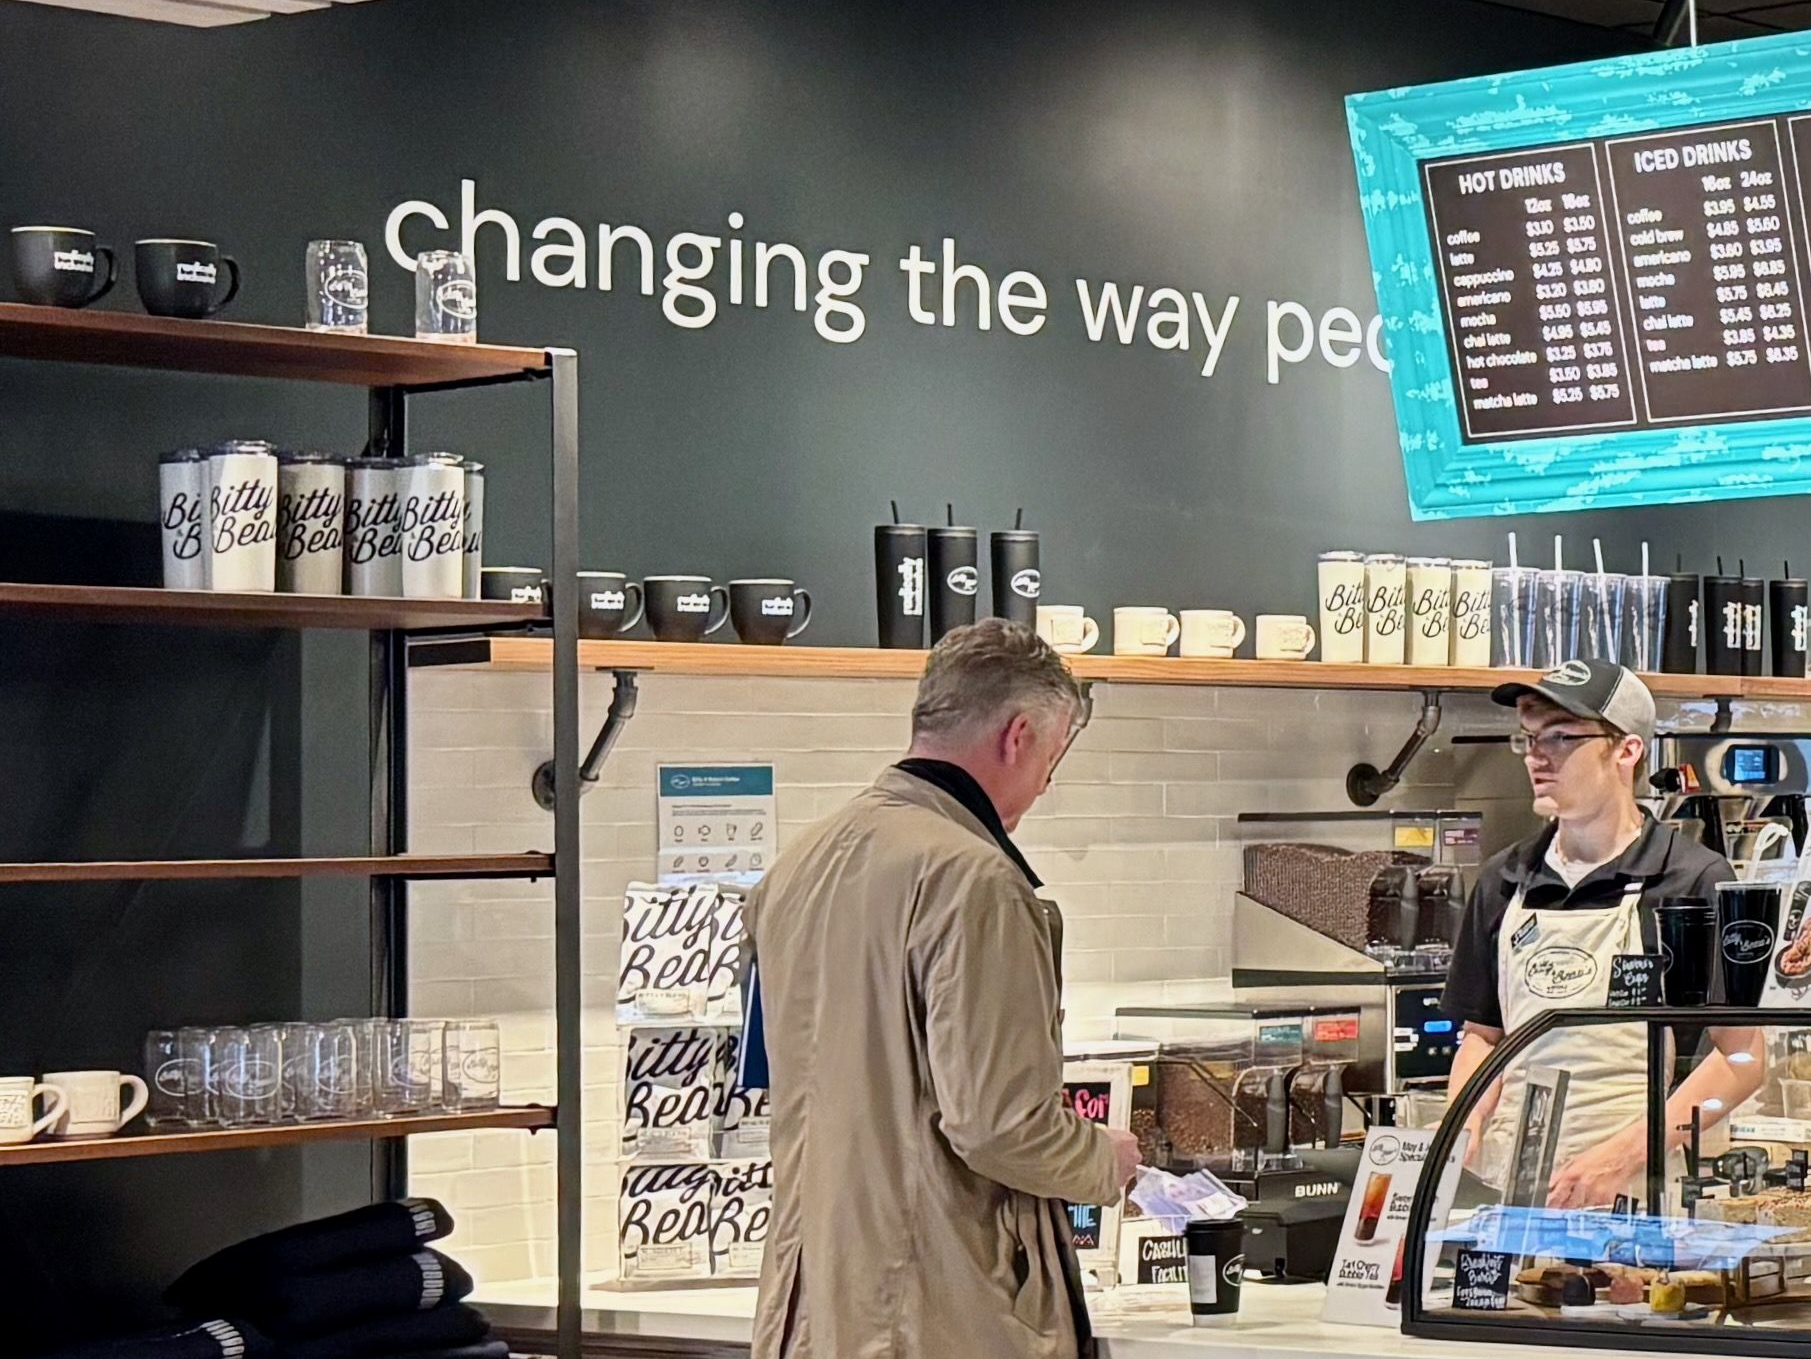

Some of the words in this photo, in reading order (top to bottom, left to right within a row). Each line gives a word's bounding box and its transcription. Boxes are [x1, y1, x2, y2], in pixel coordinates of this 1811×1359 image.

[1633, 147, 1680, 173] ICED
[1681, 138, 1753, 167] DRINKS
[1458, 170, 1498, 194] HOT
[1498, 161, 1566, 190] DRINKS
[1700, 172, 1732, 192] 16oz
[1739, 168, 1773, 188] 24oz
[1524, 195, 1553, 214] 12oz
[1561, 191, 1591, 210] 16oz
[1625, 206, 1663, 225] coffee
[1445, 228, 1481, 245] coffee
[1628, 228, 1656, 246] cold
[1654, 225, 1685, 243] brew
[1449, 250, 1475, 266] latte
[1632, 246, 1692, 267] americano
[384, 179, 869, 344] changing
[898, 239, 1047, 335] the
[1076, 277, 1239, 377] way
[1452, 266, 1515, 290] cappuccino
[1634, 270, 1676, 289] mocha
[1455, 288, 1512, 307] americano
[1638, 292, 1666, 310] latte
[1459, 311, 1496, 328] mocha
[1641, 314, 1668, 331] chai
[1666, 311, 1694, 328] latte
[1462, 333, 1486, 348] chai
[1486, 330, 1511, 346] latte
[1644, 337, 1666, 352] tea
[1465, 354, 1485, 369] hot
[1484, 348, 1538, 367] chocolate
[1648, 354, 1692, 373] matcha
[1690, 352, 1718, 369] latte
[1469, 376, 1489, 389] tea
[1472, 392, 1513, 410] matcha
[1512, 390, 1538, 406] latte
[209, 479, 273, 523] Bitty
[401, 490, 463, 532] Bitty
[213, 516, 277, 553] Bea
[284, 523, 342, 560] Bea
[1295, 1182, 1339, 1197] BUNN
